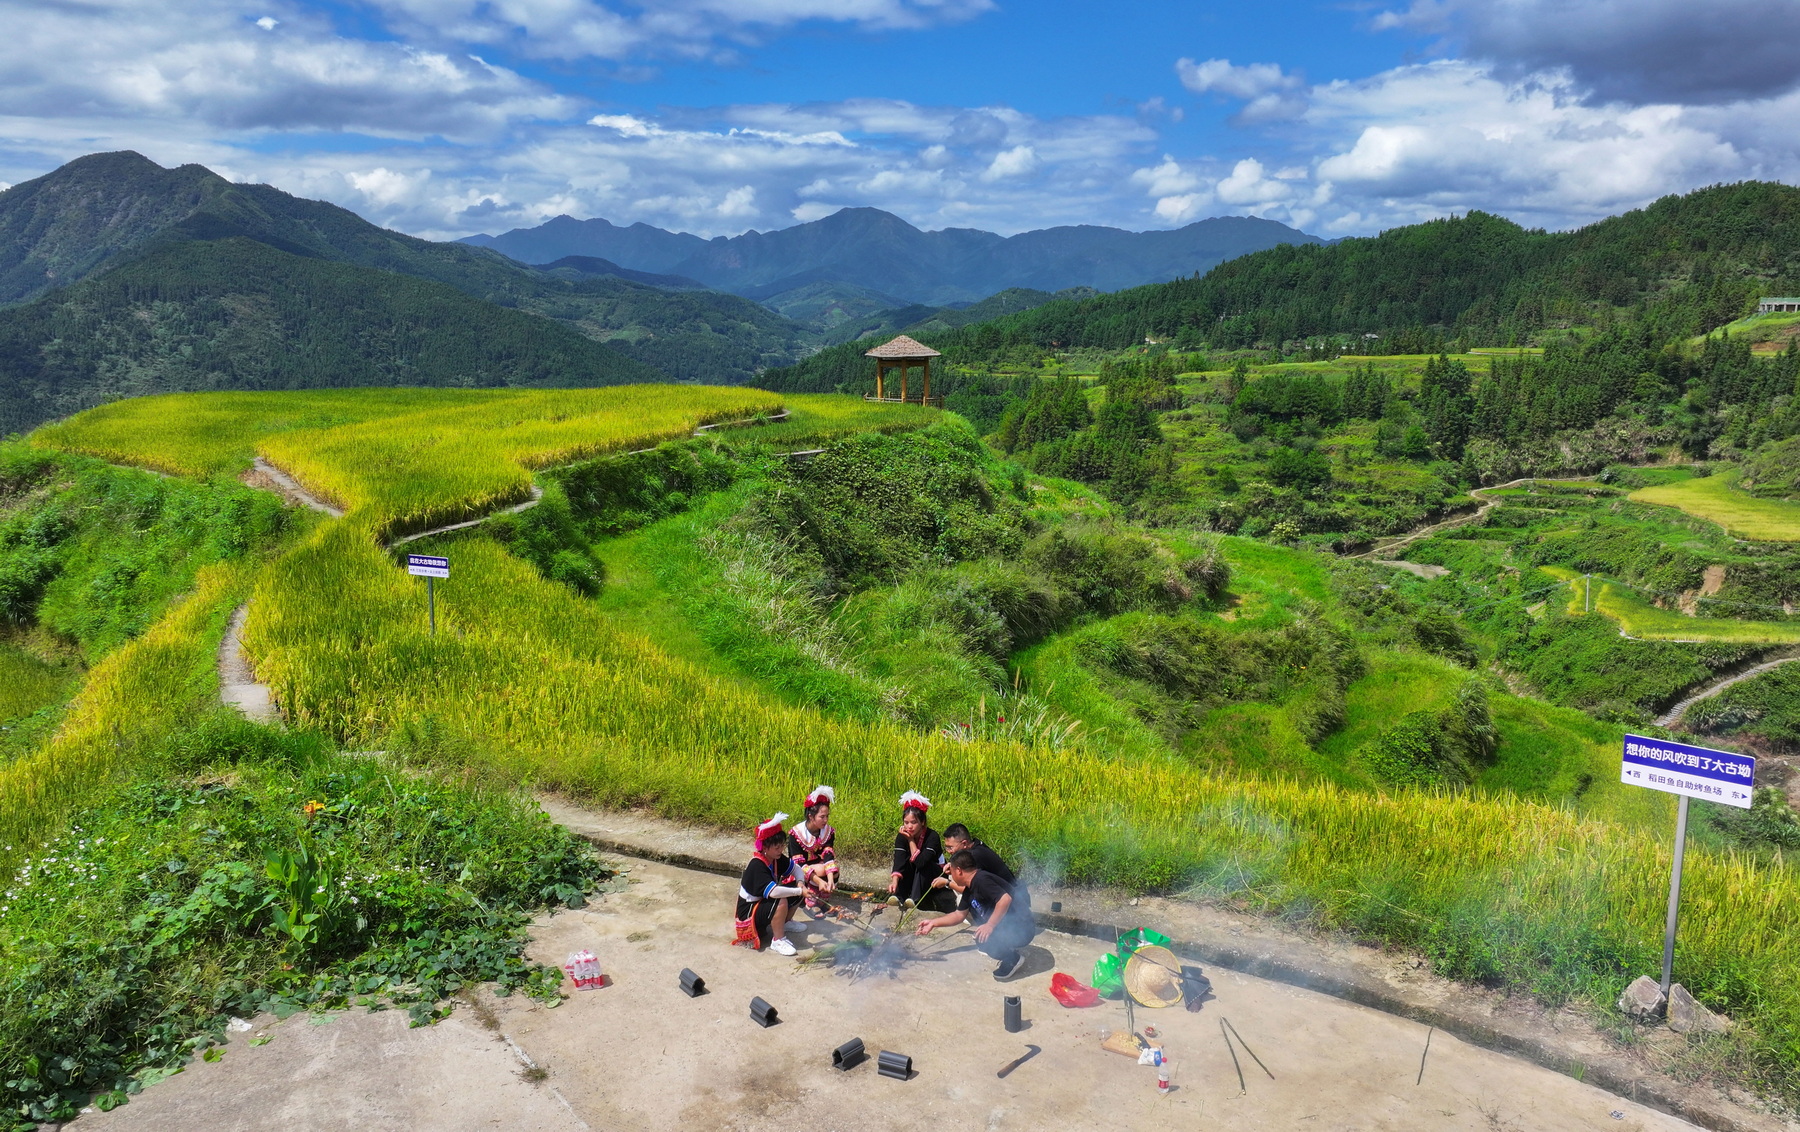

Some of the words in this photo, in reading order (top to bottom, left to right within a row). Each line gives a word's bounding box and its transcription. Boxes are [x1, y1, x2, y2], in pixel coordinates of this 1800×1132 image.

[1626, 742, 1751, 778] 想你的风吹到了大古坳
[1633, 770, 1641, 778] 西
[1648, 773, 1722, 796] 稻田鱼自助烤鱼场
[1731, 791, 1740, 799] 东
